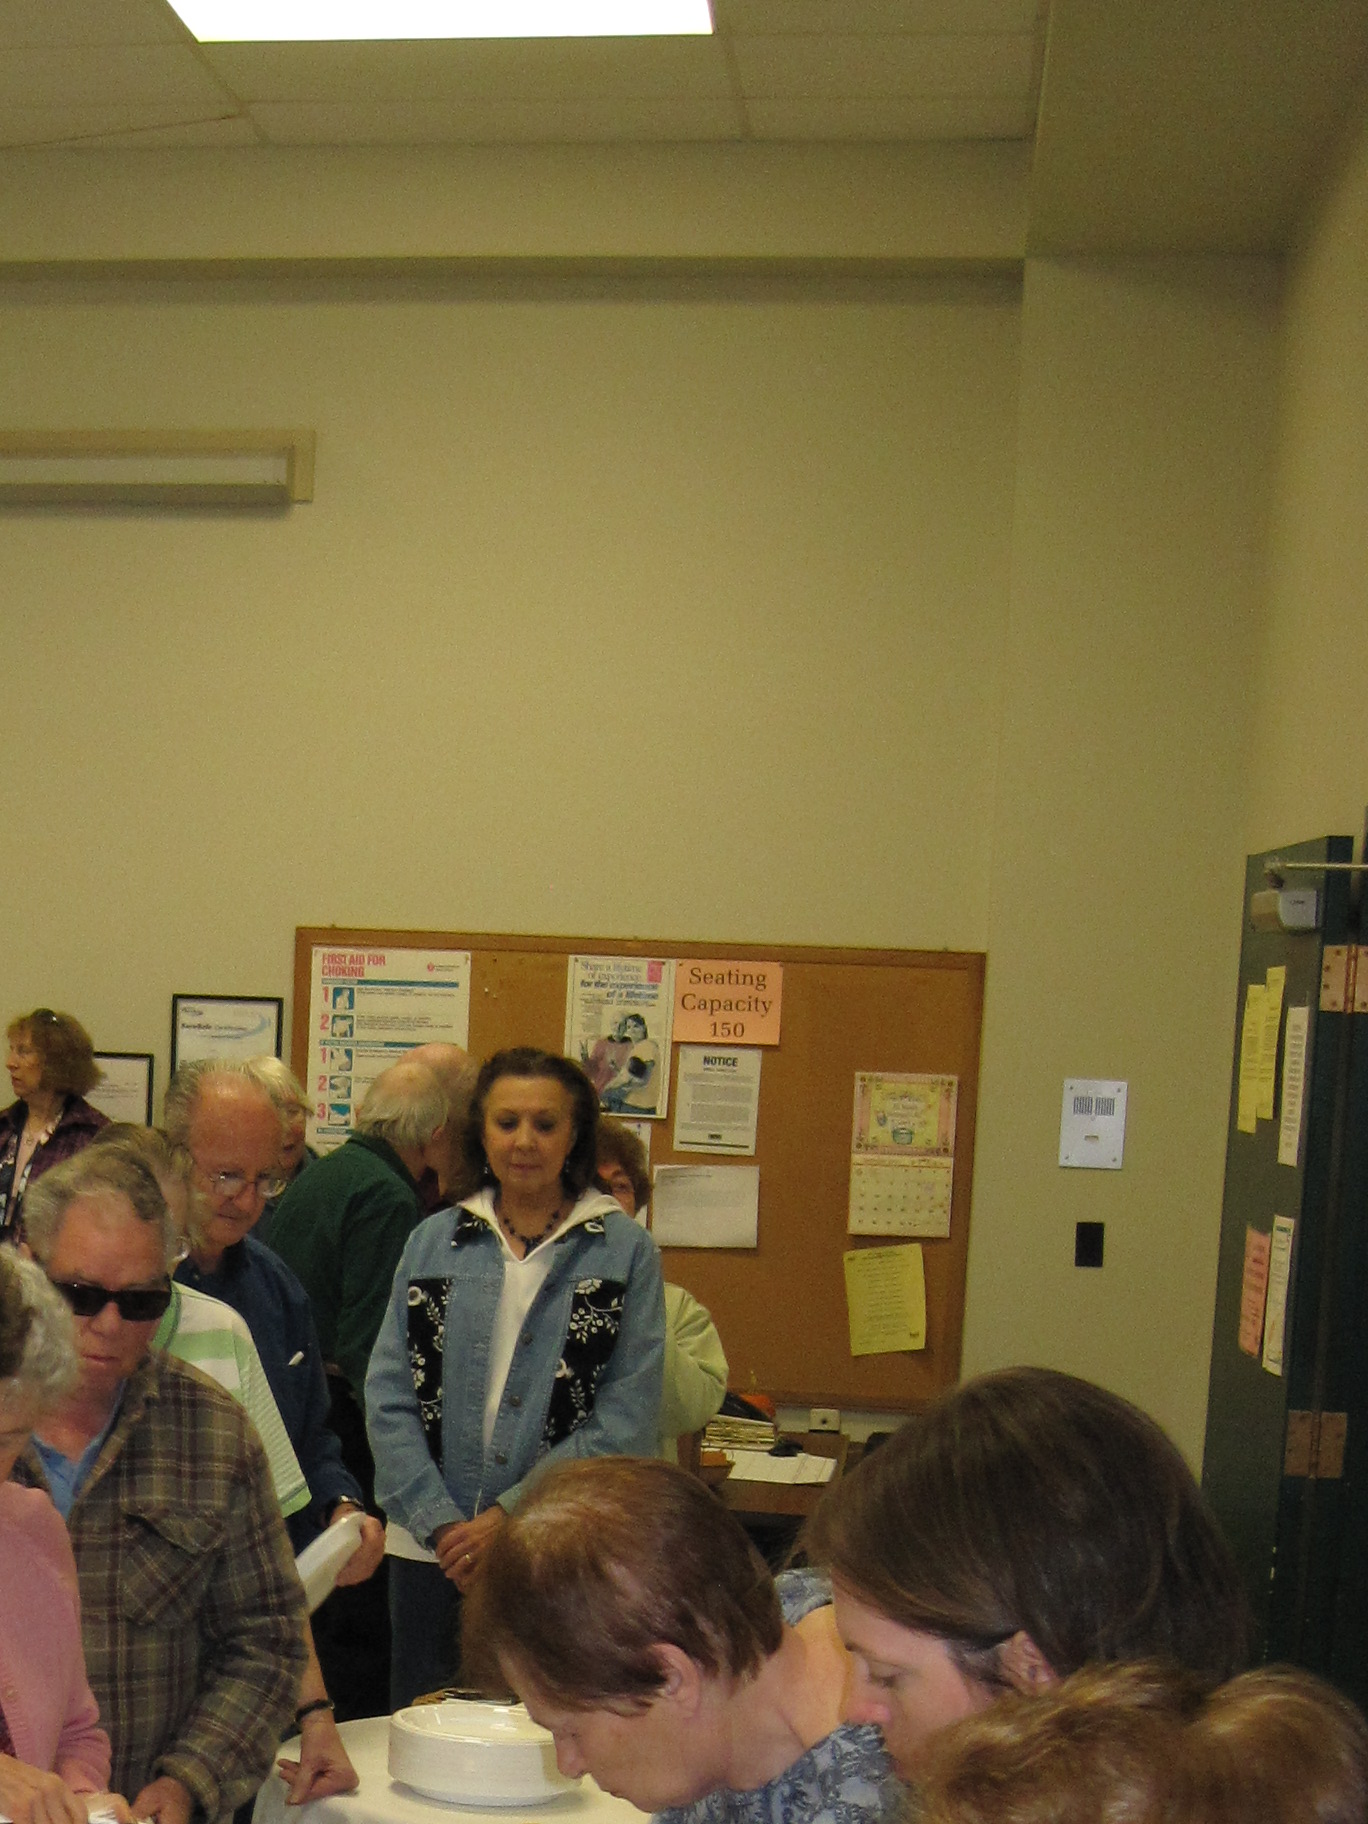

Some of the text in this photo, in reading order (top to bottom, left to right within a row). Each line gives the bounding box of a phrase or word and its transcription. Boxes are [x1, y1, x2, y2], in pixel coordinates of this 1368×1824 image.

[322, 953, 386, 966] FIRST AID FOR
[321, 965, 365, 977] CHOKING
[689, 967, 767, 991] Seating
[322, 986, 329, 1002] 1
[681, 993, 772, 1017] Capacity
[319, 1014, 330, 1031] 2
[711, 1021, 745, 1038] 150
[321, 1047, 327, 1063] 1
[703, 1056, 738, 1067] NOTICE
[318, 1075, 327, 1092] 2
[317, 1103, 327, 1120] 3
